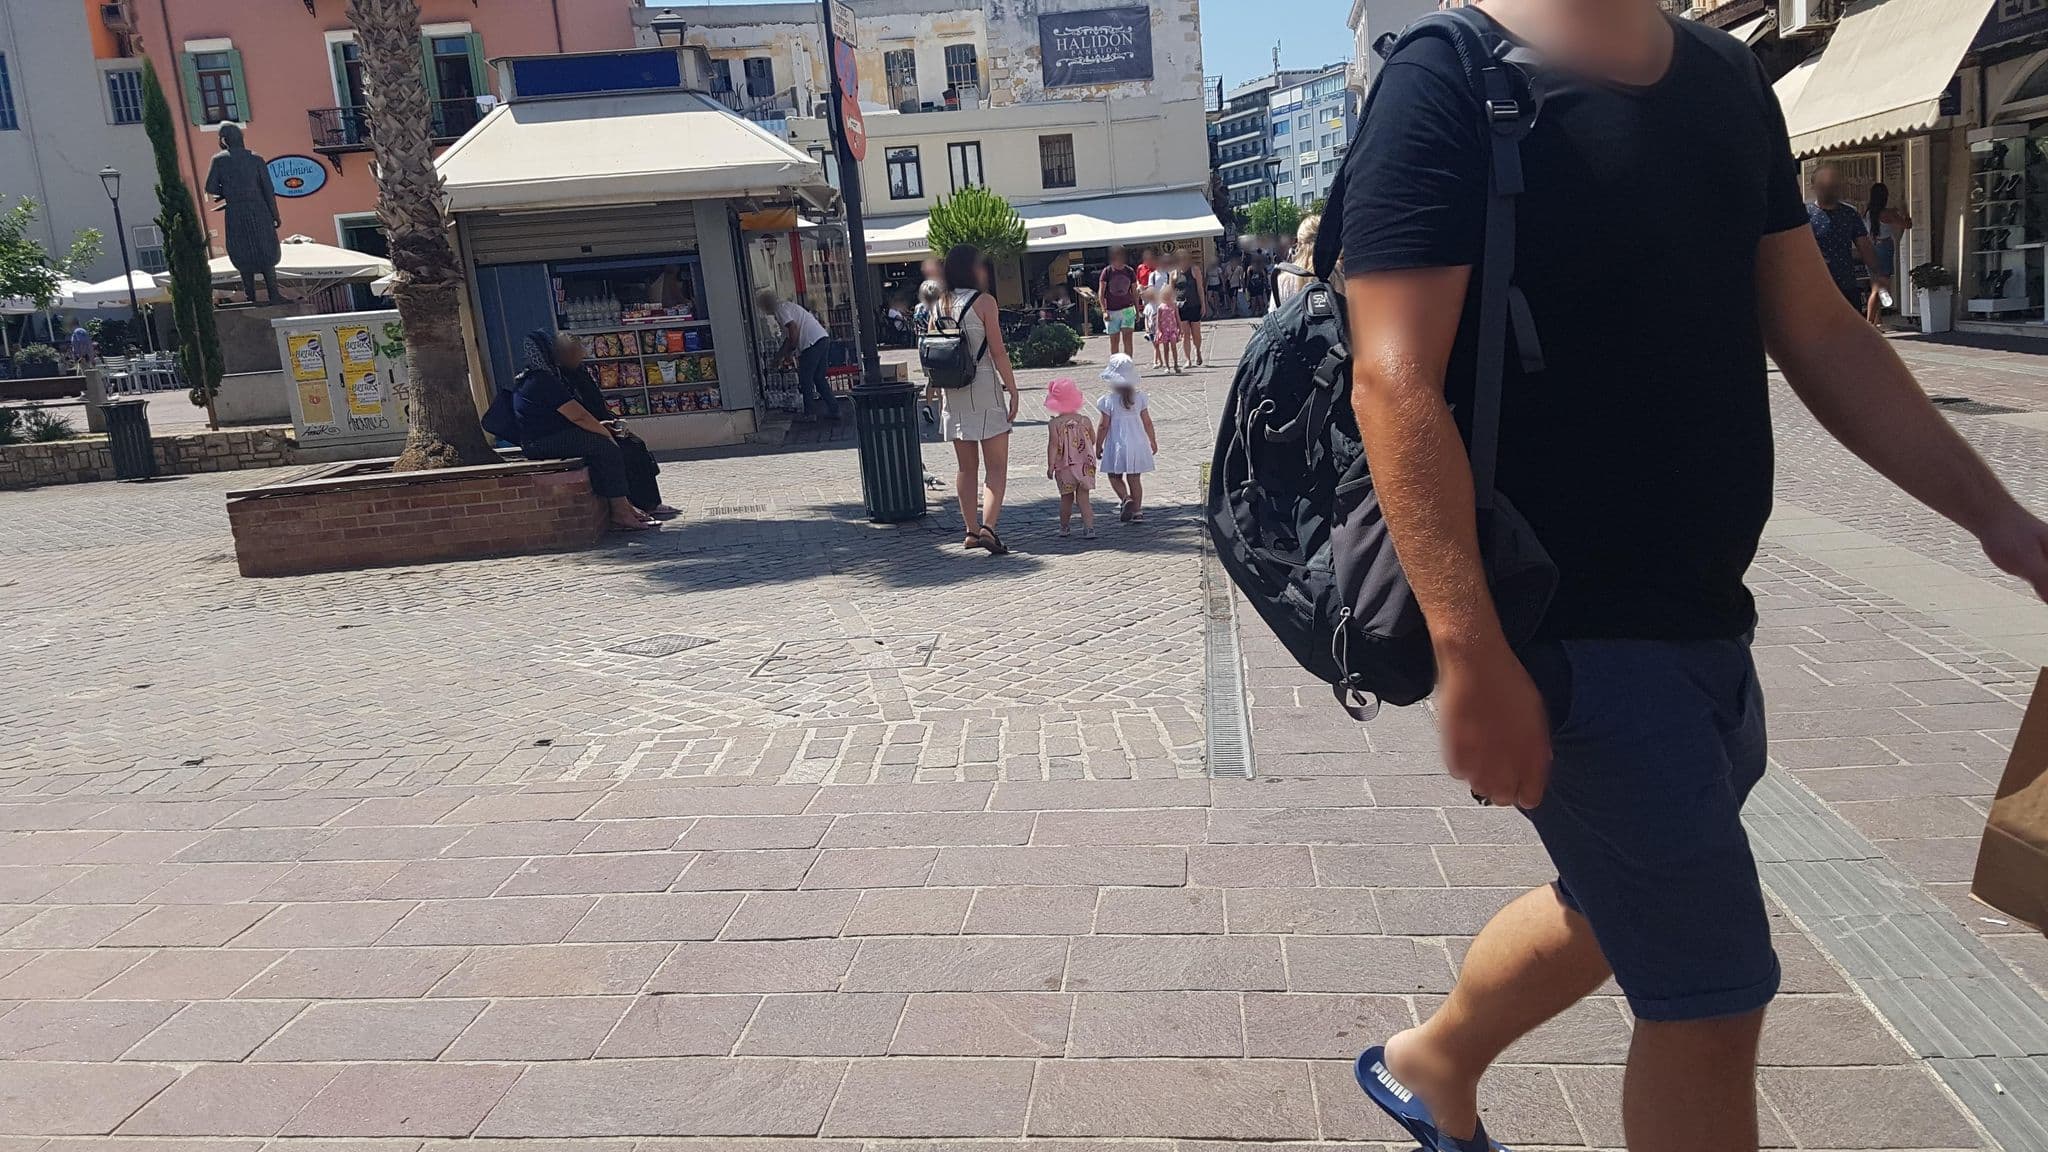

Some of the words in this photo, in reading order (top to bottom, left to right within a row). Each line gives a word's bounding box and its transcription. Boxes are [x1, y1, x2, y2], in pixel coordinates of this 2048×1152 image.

[1056, 32, 1133, 51] HALIDON
[1071, 46, 1121, 56] PANSION
[1370, 1061, 1414, 1103] PUMA
